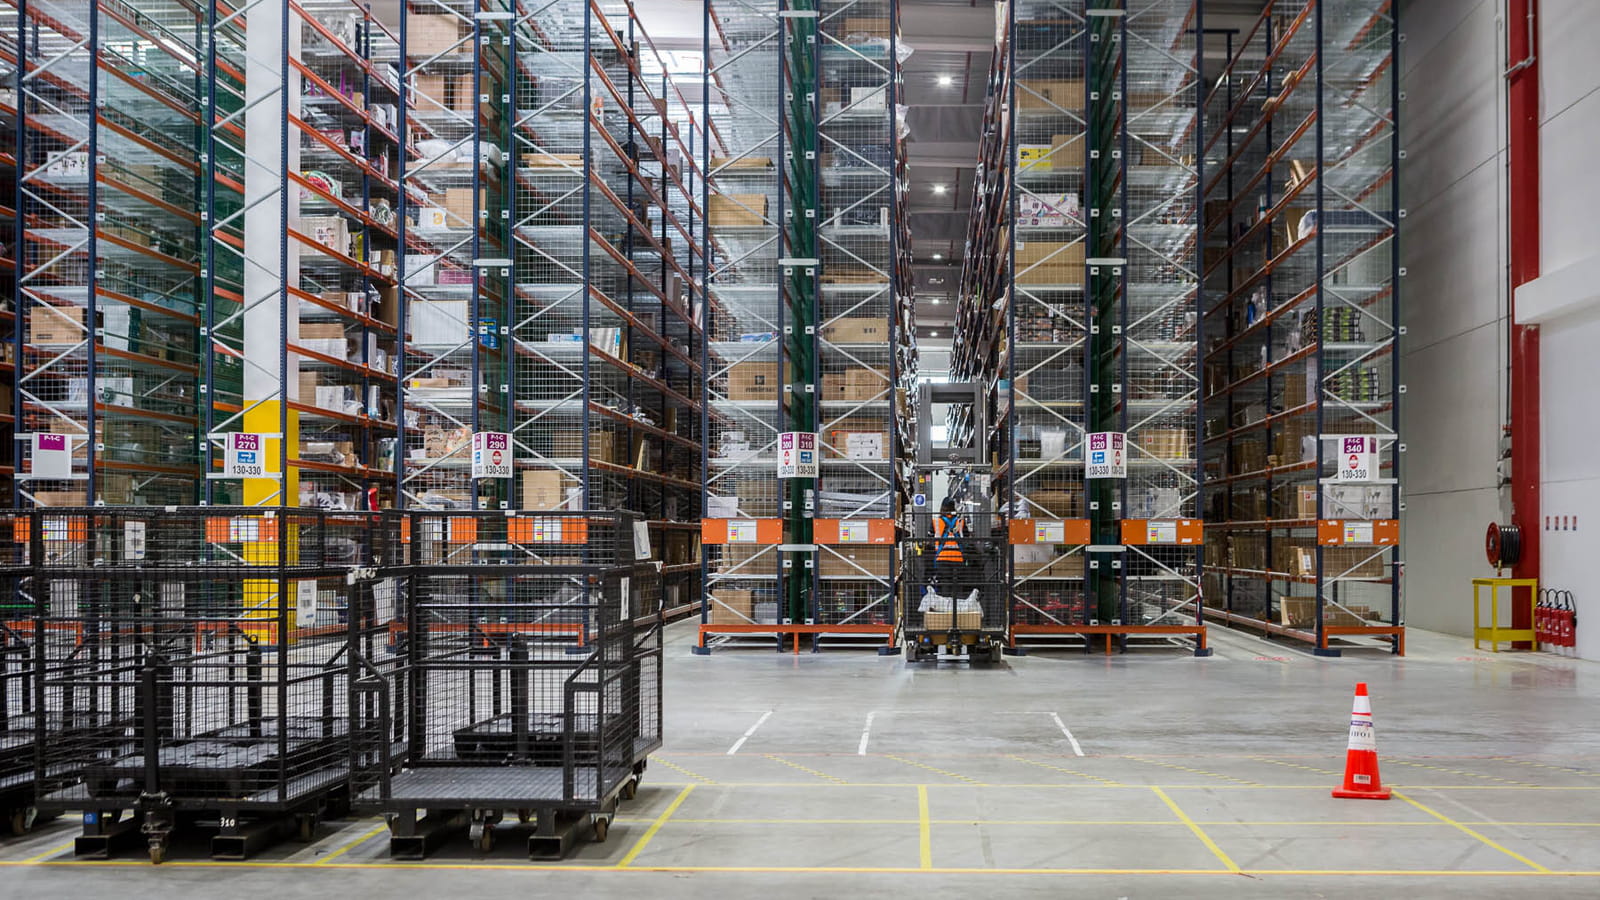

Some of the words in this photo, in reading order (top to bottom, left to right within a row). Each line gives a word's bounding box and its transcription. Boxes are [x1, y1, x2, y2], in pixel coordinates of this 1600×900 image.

[238, 441, 256, 449] 270
[489, 441, 505, 449] 290
[799, 441, 813, 449] 310
[1092, 441, 1105, 450] 320
[1345, 445, 1362, 453] 340
[233, 465, 261, 475] 130-330
[485, 465, 510, 475] 130-330
[797, 465, 816, 475] 130-330
[1089, 465, 1110, 476] 130-330
[1342, 469, 1368, 479] 130-330
